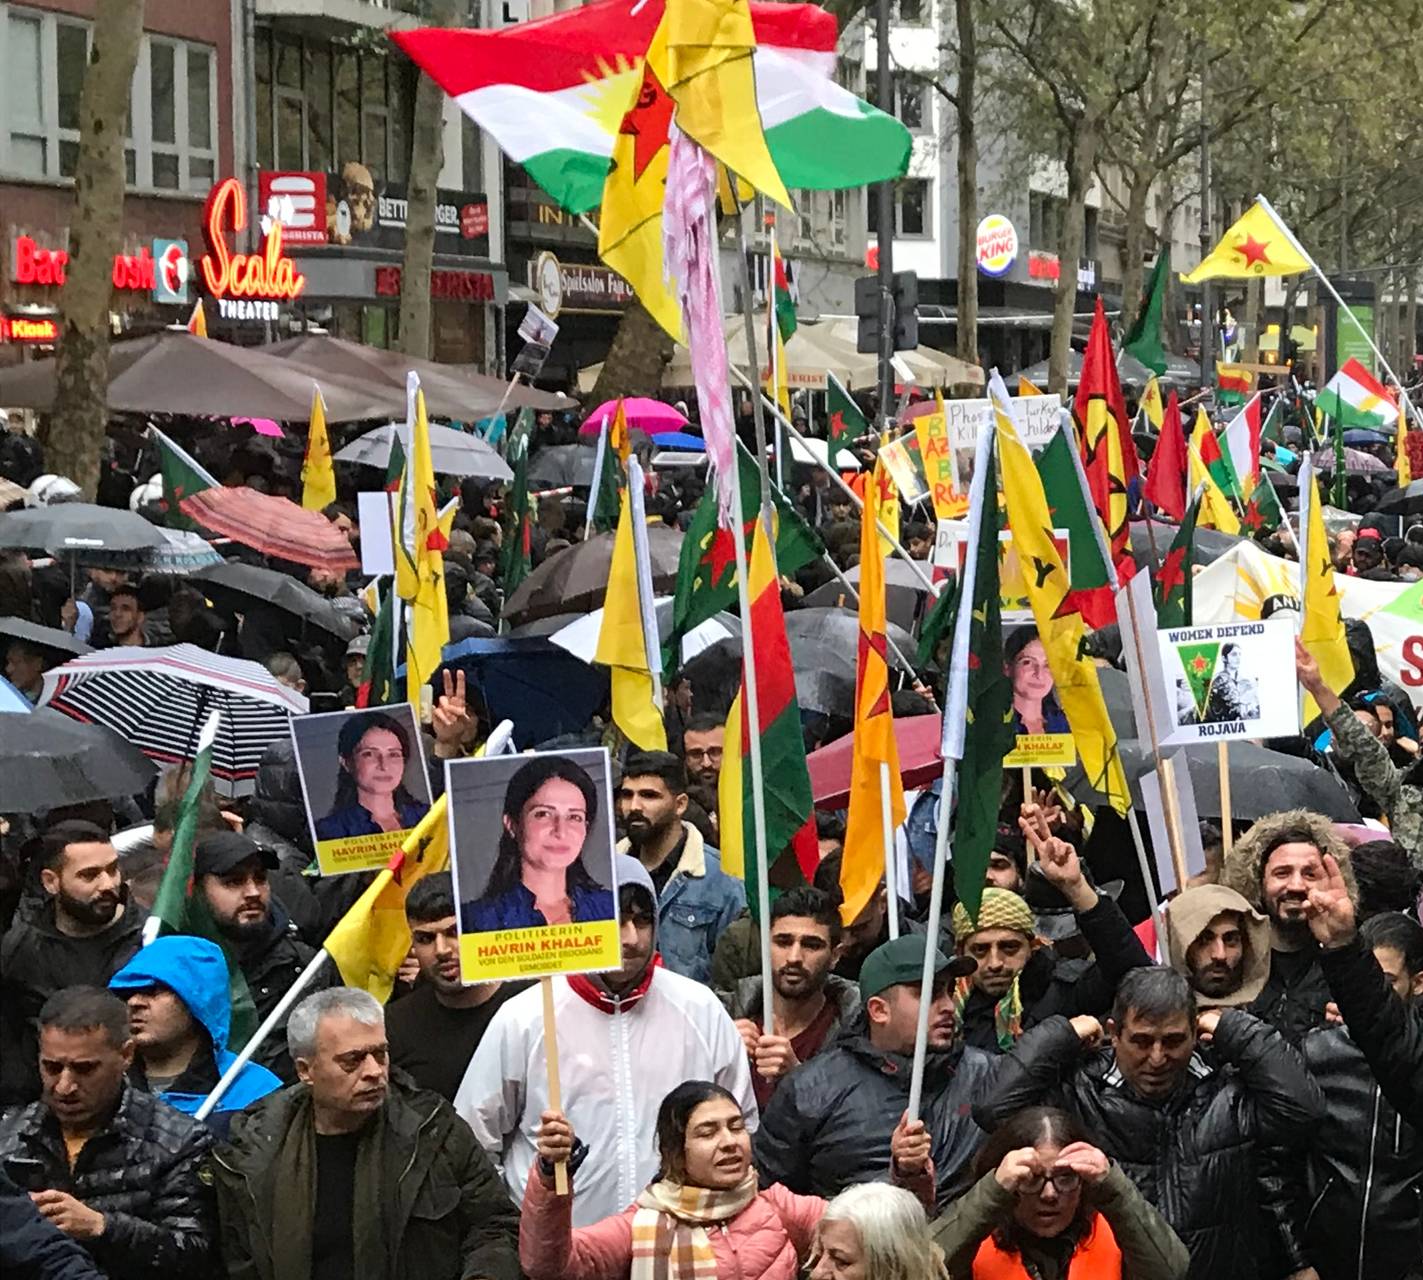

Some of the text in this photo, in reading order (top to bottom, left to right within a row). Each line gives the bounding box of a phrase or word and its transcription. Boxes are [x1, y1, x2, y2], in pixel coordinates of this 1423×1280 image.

[202, 178, 304, 298] Scala
[979, 238, 1014, 261] KING
[218, 299, 278, 320] THEATER
[1168, 624, 1265, 642] WOMEN DEFEND
[1198, 722, 1246, 736] ROJAVA
[332, 844, 377, 857] HAVRIN
[495, 925, 583, 941] POLITIKERIN
[478, 935, 603, 957] HAVRIN KHALAF
[478, 957, 496, 967] VON
[498, 955, 514, 964] DEN
[516, 952, 557, 962] SOLDATEN
